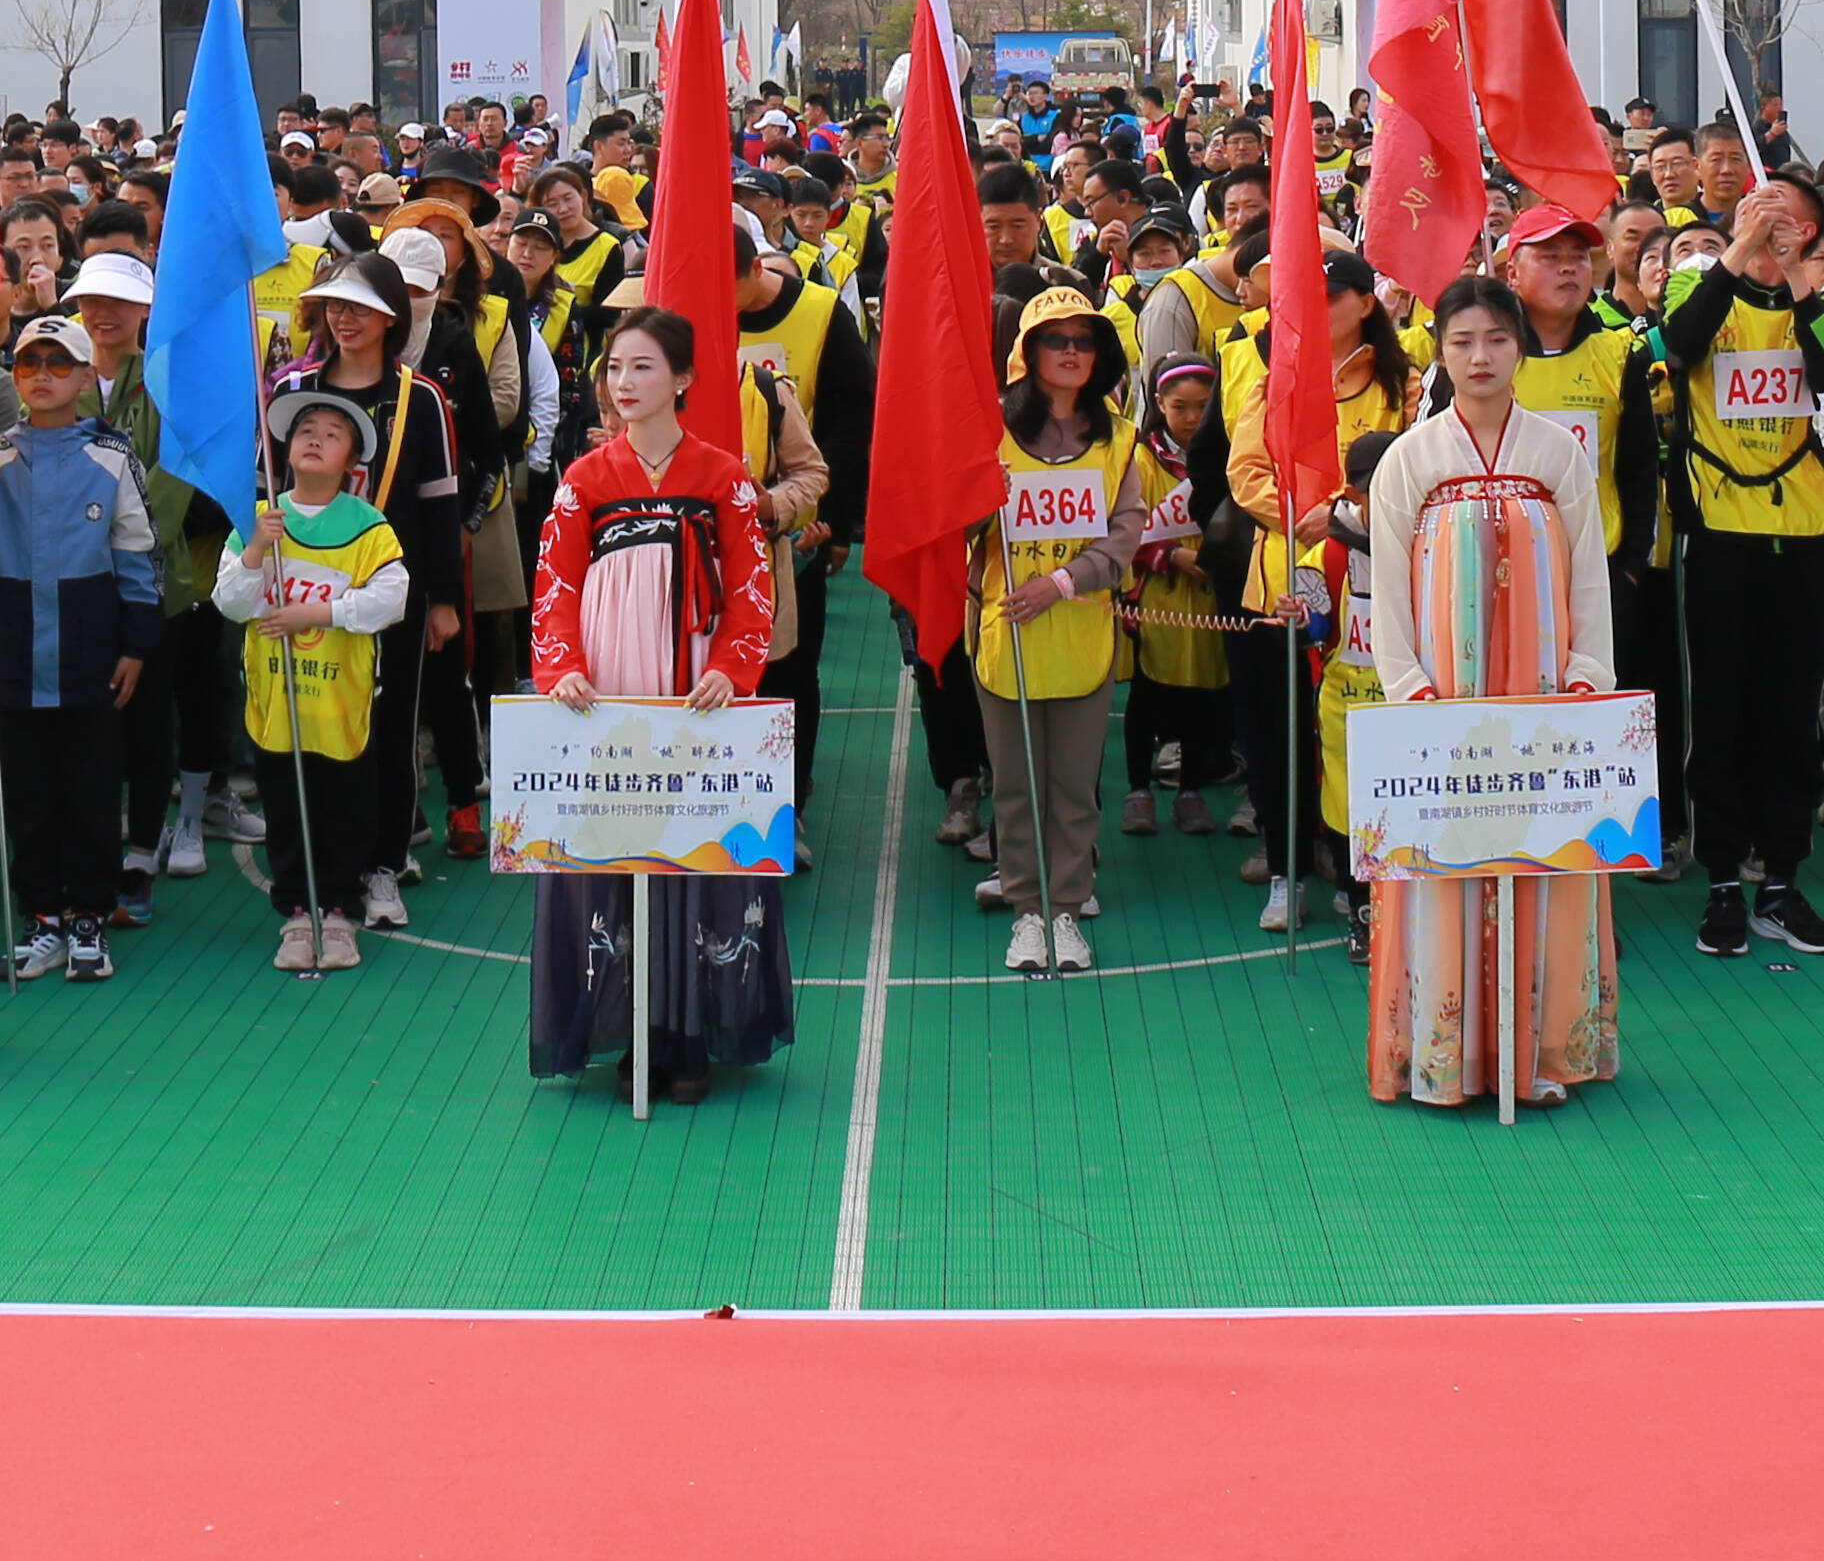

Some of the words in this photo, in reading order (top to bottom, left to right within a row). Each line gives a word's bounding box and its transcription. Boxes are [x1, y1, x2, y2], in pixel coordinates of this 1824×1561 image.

[1726, 367, 1804, 406] A237
[1014, 488, 1097, 528] A364
[512, 771, 774, 794] 2024年徒步齐鲁“东港”站
[1372, 765, 1637, 799] 2024年徒步齐鲁“东港”站
